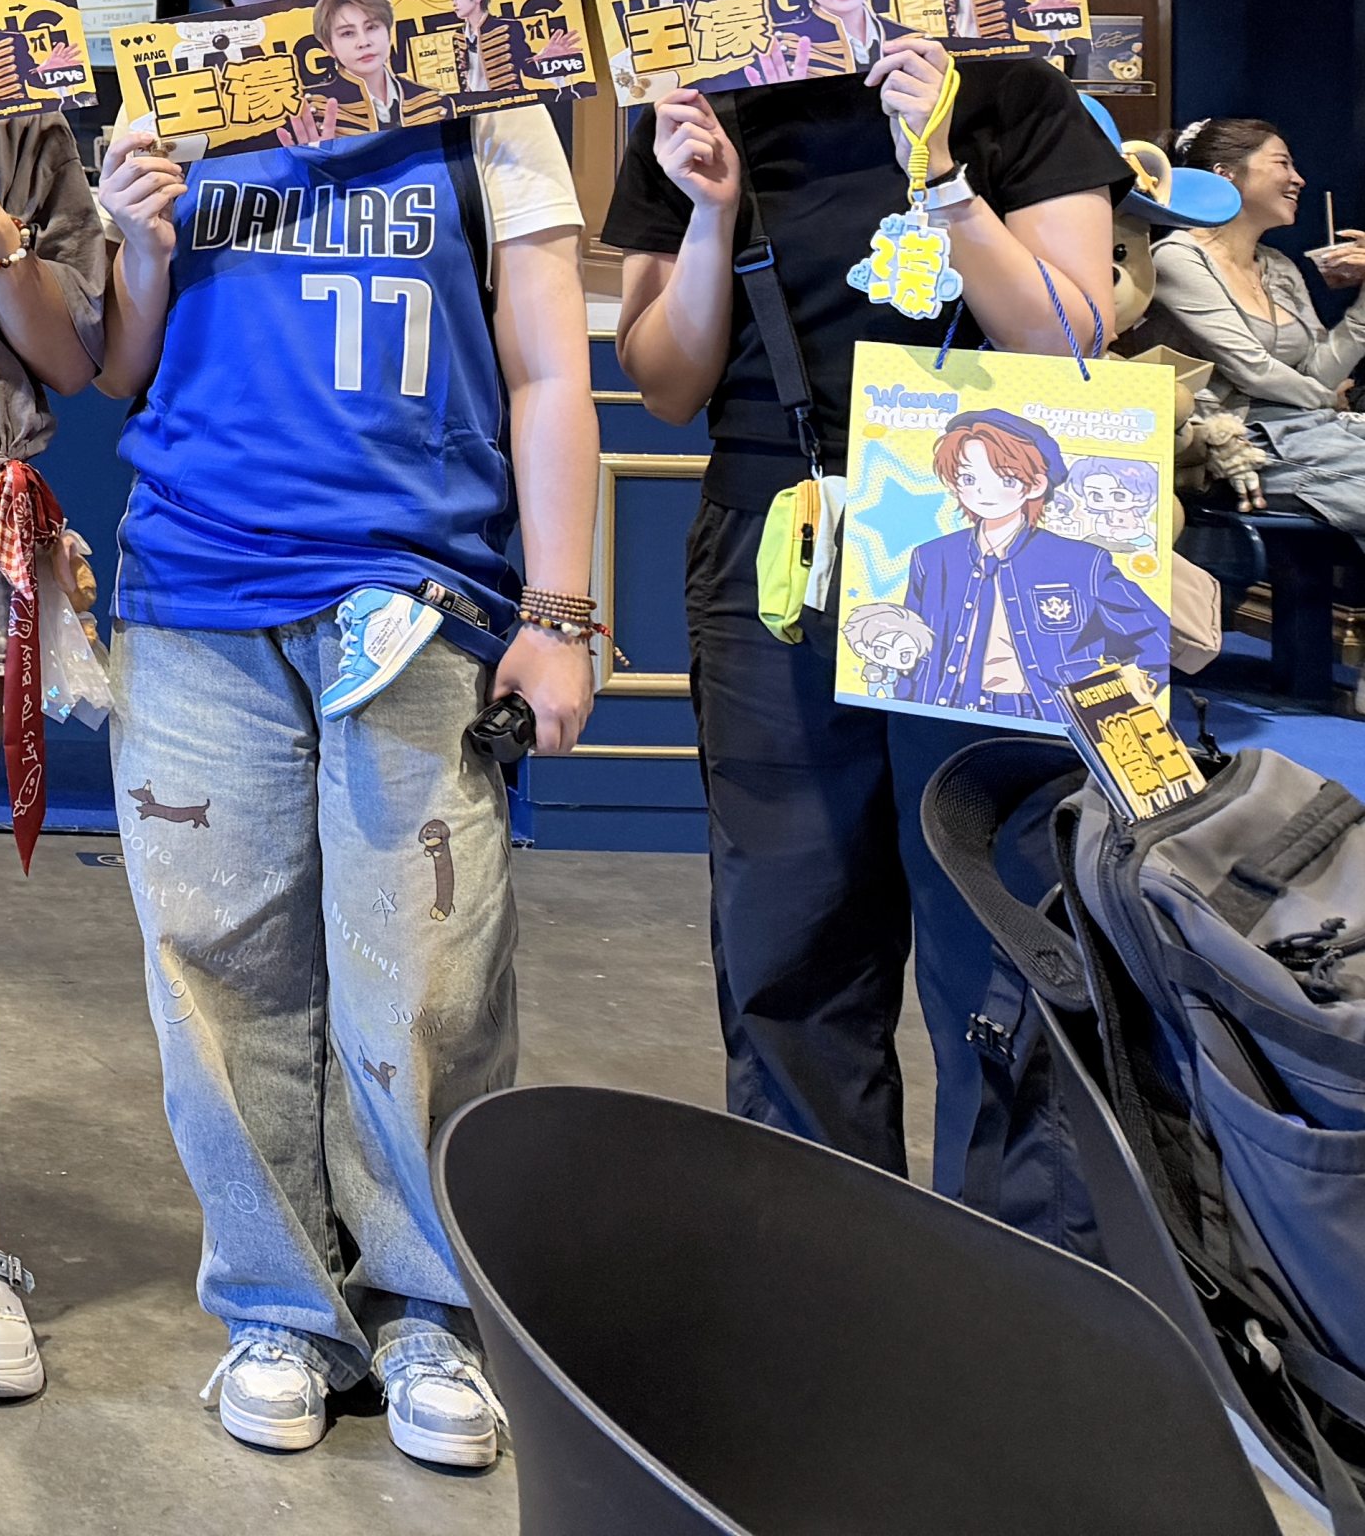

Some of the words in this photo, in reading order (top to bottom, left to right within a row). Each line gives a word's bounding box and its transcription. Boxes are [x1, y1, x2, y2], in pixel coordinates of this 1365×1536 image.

[132, 48, 167, 63] WANG
[149, 55, 304, 138] 王濛
[191, 180, 436, 258] DALLAS
[301, 273, 433, 397] 77
[864, 384, 959, 413] Wang
